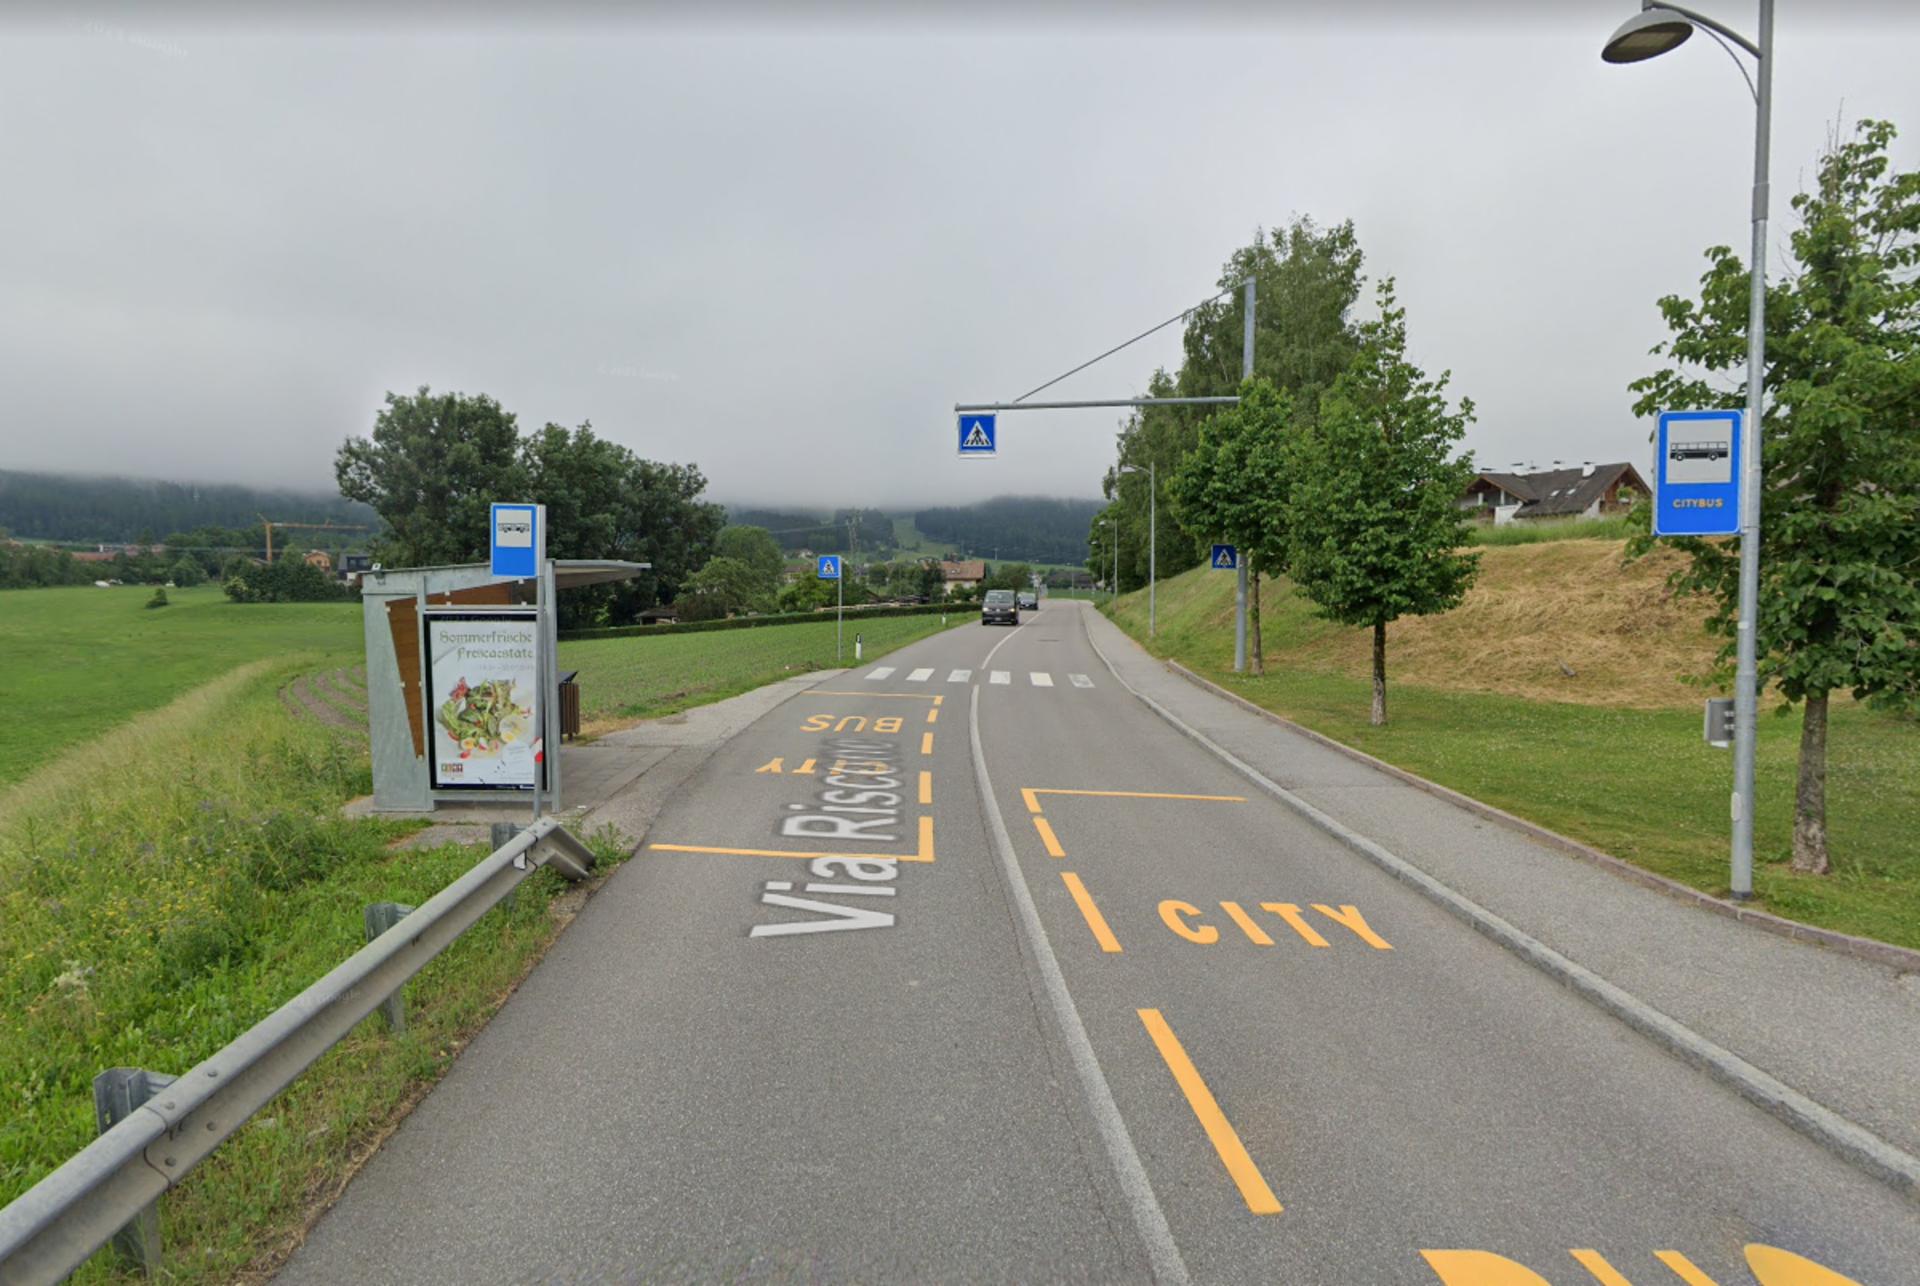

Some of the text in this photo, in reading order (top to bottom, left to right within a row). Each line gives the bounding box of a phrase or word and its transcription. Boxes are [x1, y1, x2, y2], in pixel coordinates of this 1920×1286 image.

[1672, 498, 1724, 509] CITYBUS
[800, 713, 904, 734] BUS
[1157, 899, 1394, 950] CITY
